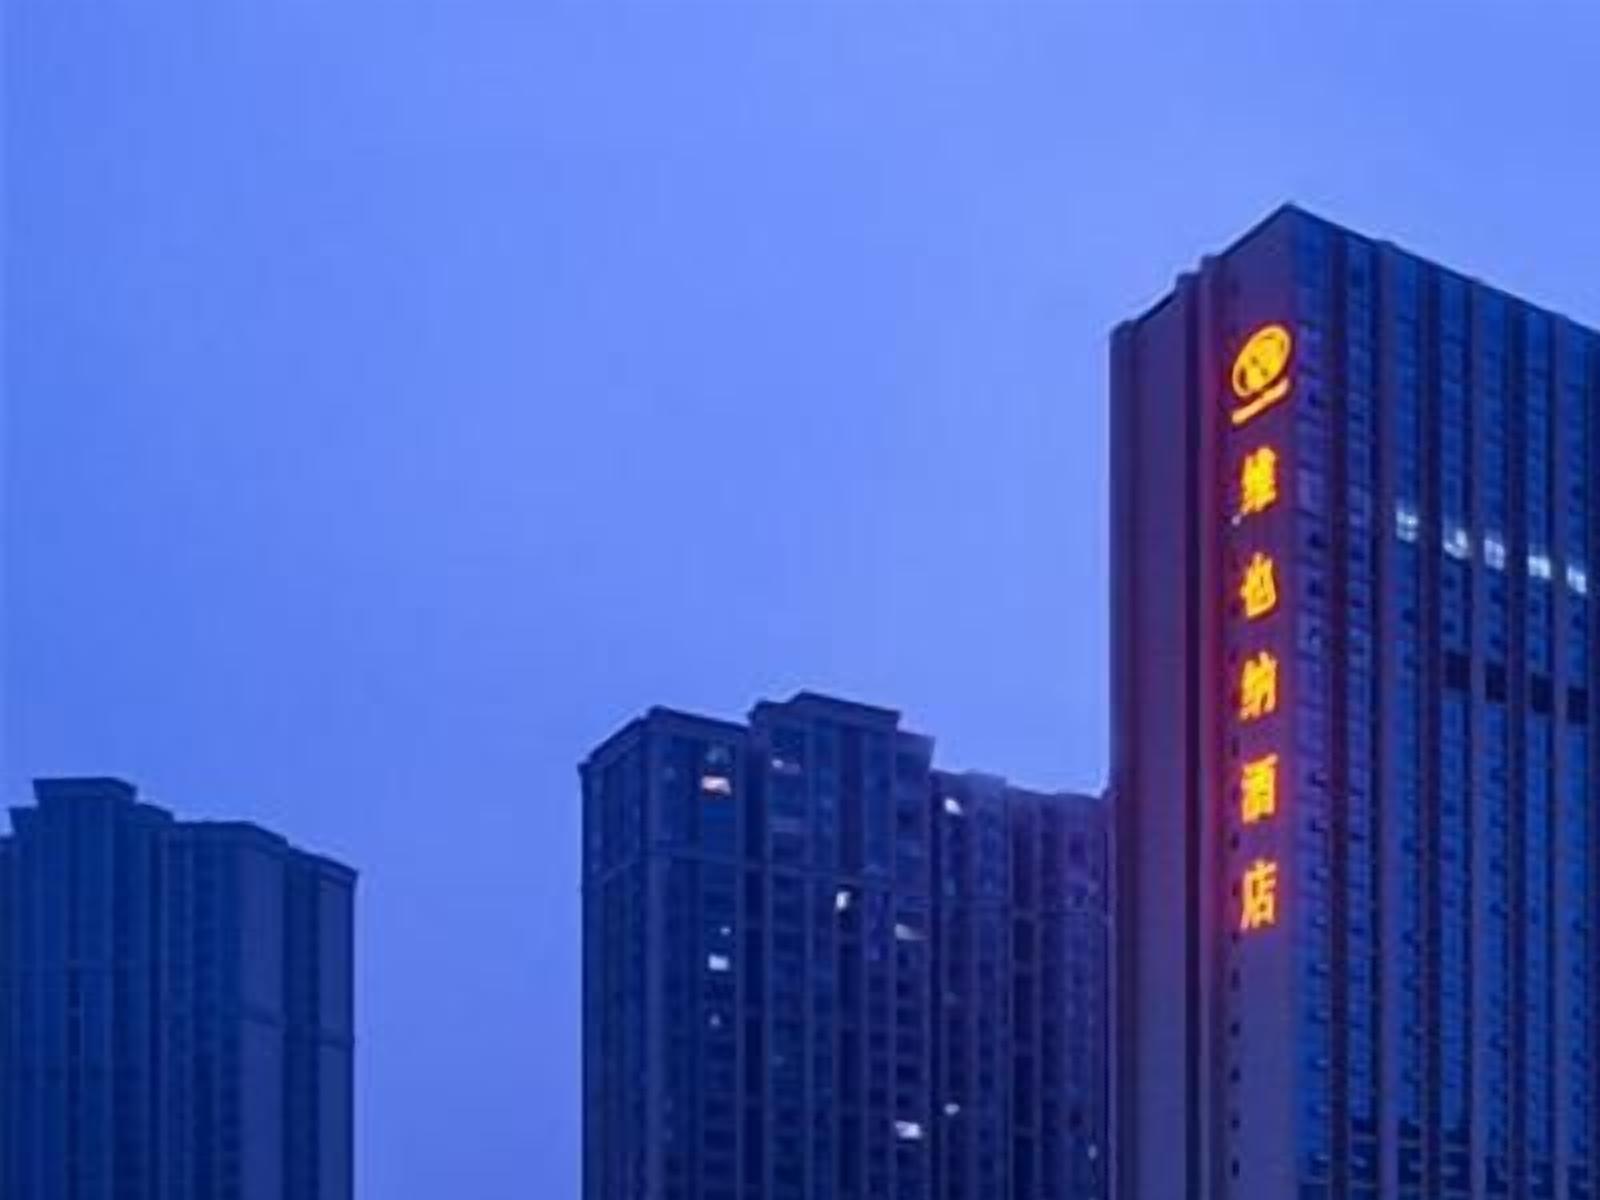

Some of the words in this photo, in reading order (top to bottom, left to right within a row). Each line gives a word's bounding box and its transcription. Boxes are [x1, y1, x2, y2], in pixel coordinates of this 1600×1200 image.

[1239, 446, 1278, 929] 维也纳酒店
